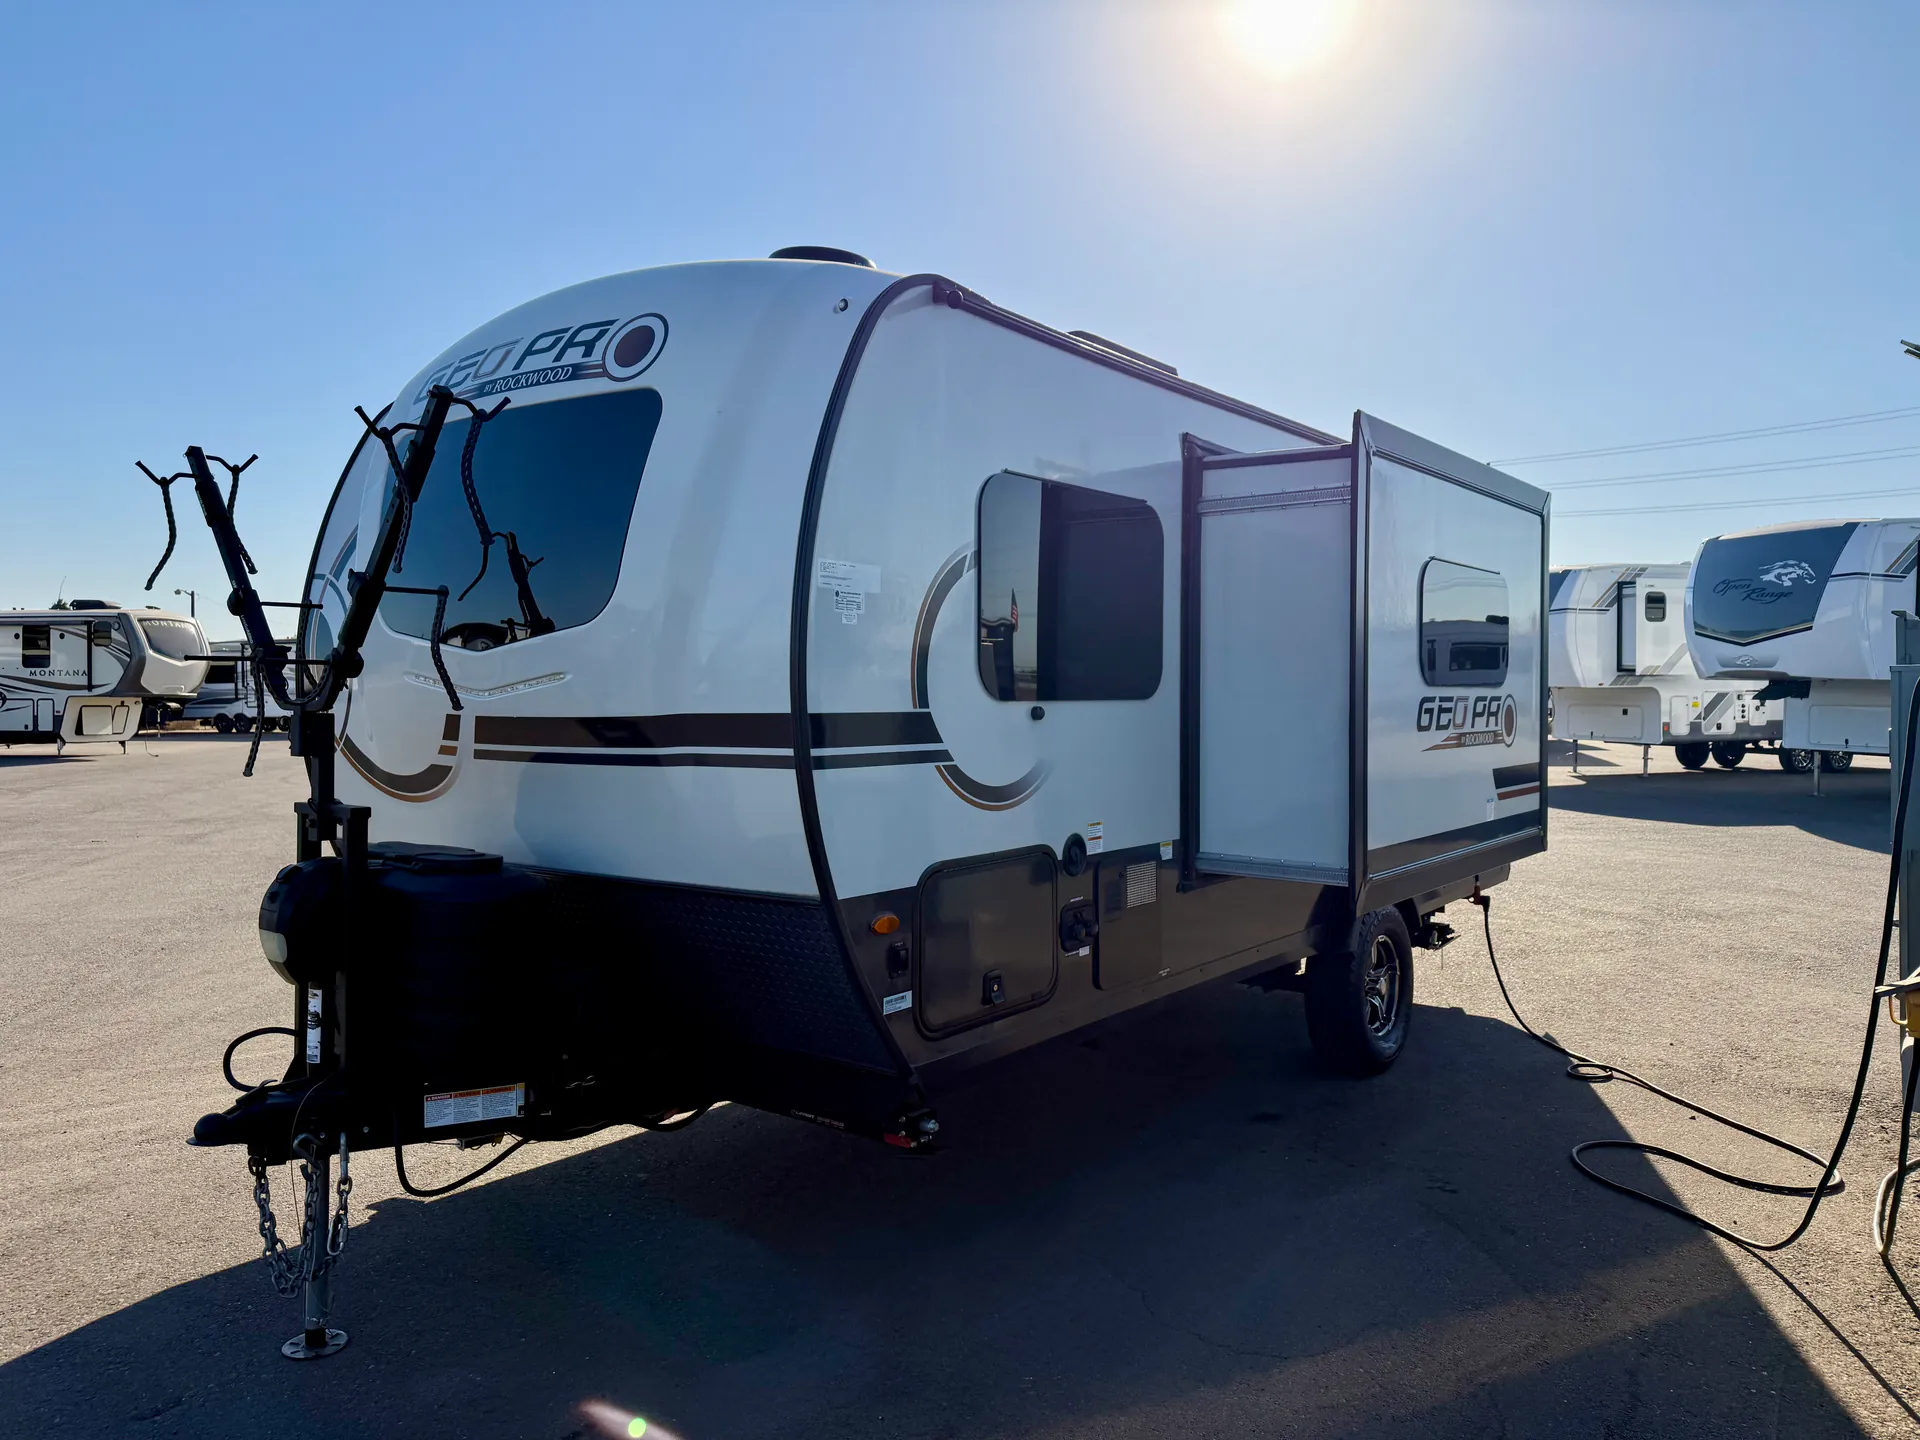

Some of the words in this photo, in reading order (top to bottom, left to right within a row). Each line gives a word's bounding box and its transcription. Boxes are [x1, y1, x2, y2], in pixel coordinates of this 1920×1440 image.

[512, 312, 669, 383] PRO
[483, 383, 495, 393] BY
[493, 366, 573, 393] ROCKWOOD
[1713, 578, 1753, 598] Open
[1741, 587, 1794, 605] Range
[29, 669, 88, 677] MONTANA
[1417, 695, 1470, 732] GEO
[1470, 693, 1517, 748] PRO
